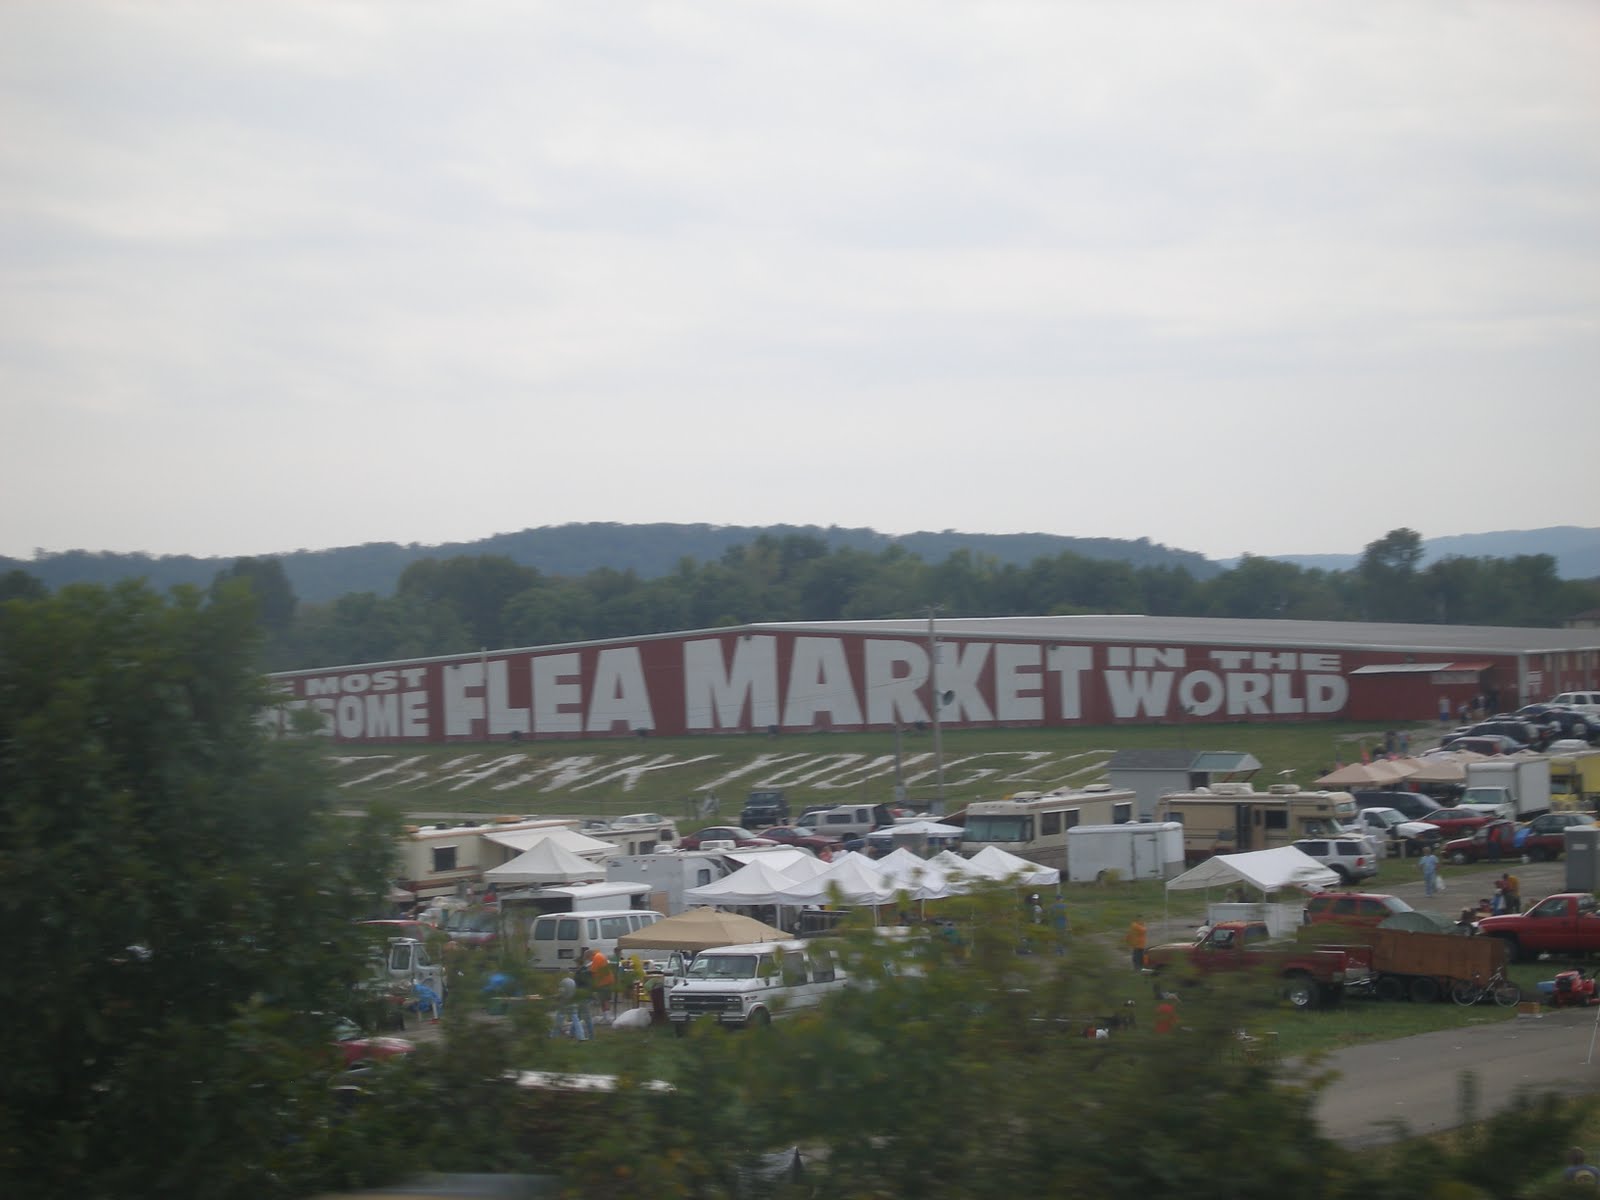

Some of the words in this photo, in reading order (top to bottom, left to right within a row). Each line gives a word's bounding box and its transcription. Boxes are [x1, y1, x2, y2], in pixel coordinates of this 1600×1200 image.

[1107, 646, 1186, 668] IN
[1210, 650, 1341, 672] THE
[304, 667, 428, 696] MOST
[443, 646, 655, 736] FLEA
[683, 635, 1093, 729] MARKET
[1104, 669, 1349, 718] WORLD
